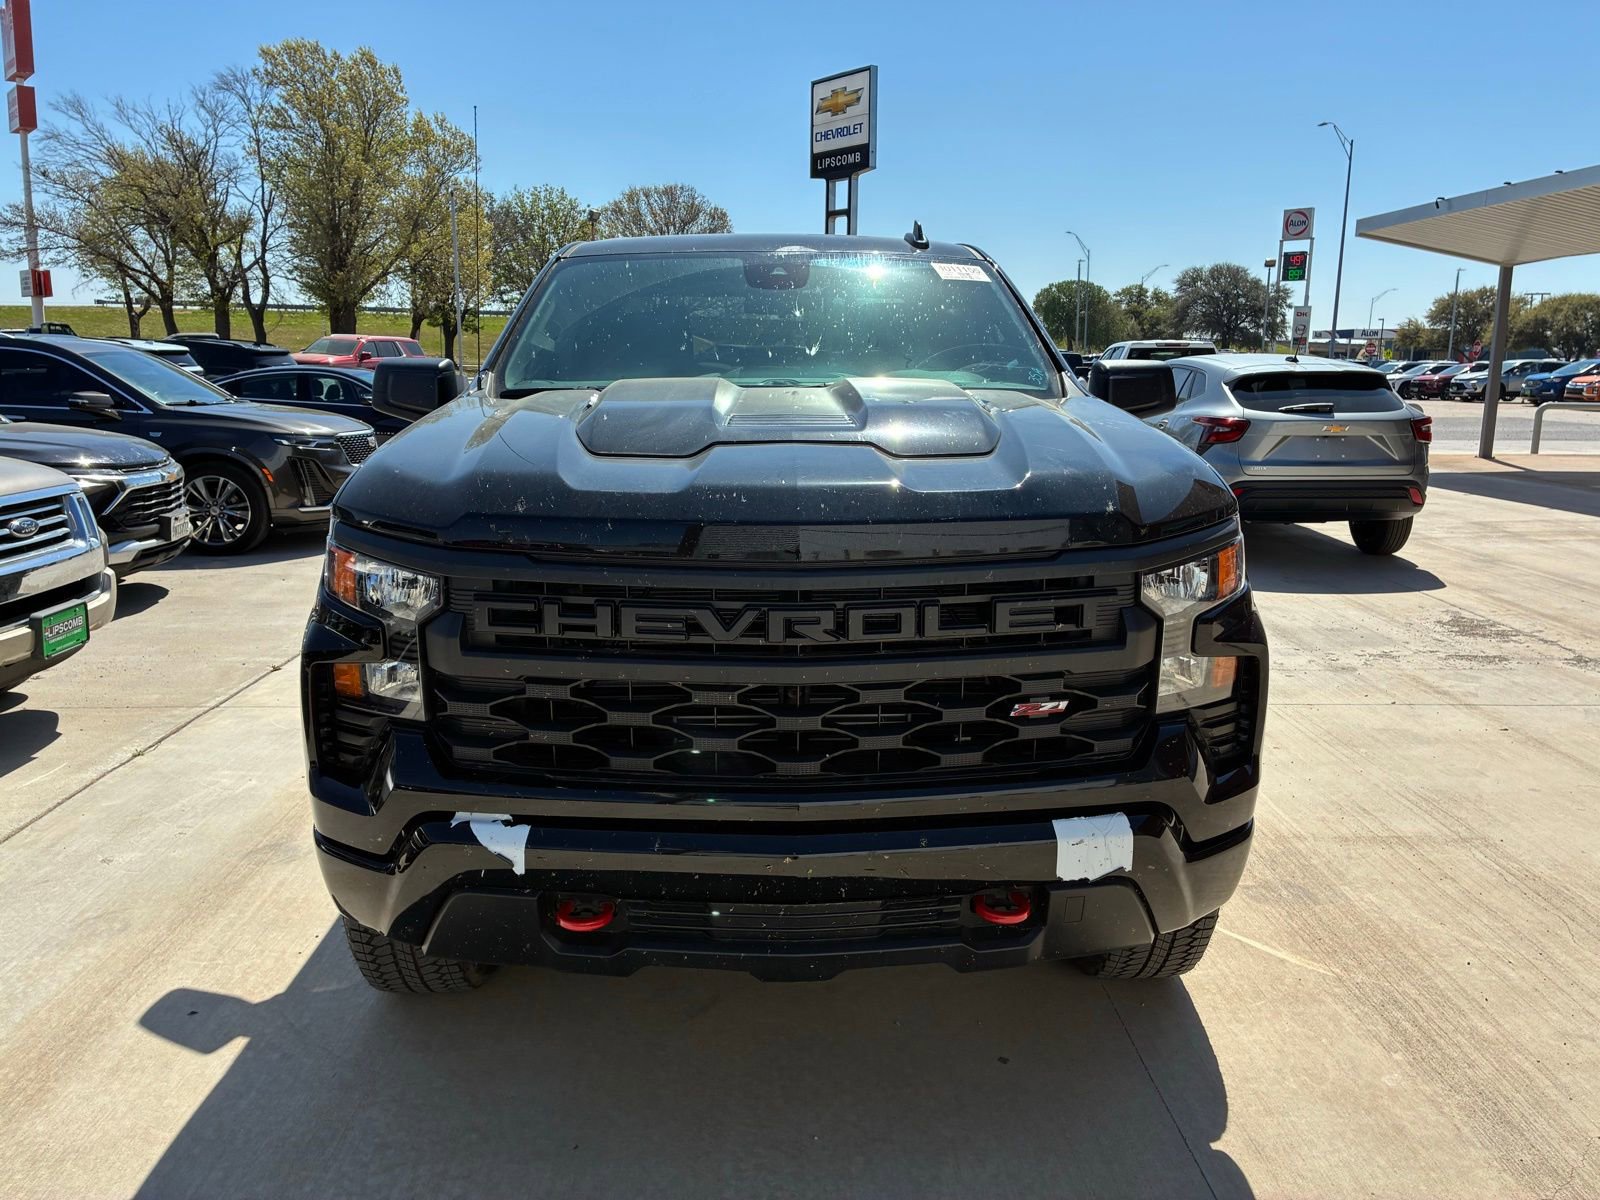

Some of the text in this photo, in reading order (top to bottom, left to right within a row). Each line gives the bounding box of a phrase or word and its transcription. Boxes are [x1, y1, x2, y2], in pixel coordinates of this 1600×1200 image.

[815, 122, 864, 143] CHEVROLET
[817, 152, 861, 169] LIPSCOMB
[1360, 328, 1379, 337] ALON
[48, 615, 83, 638] LIPSCOMB
[475, 592, 1104, 645] CHEVROLET
